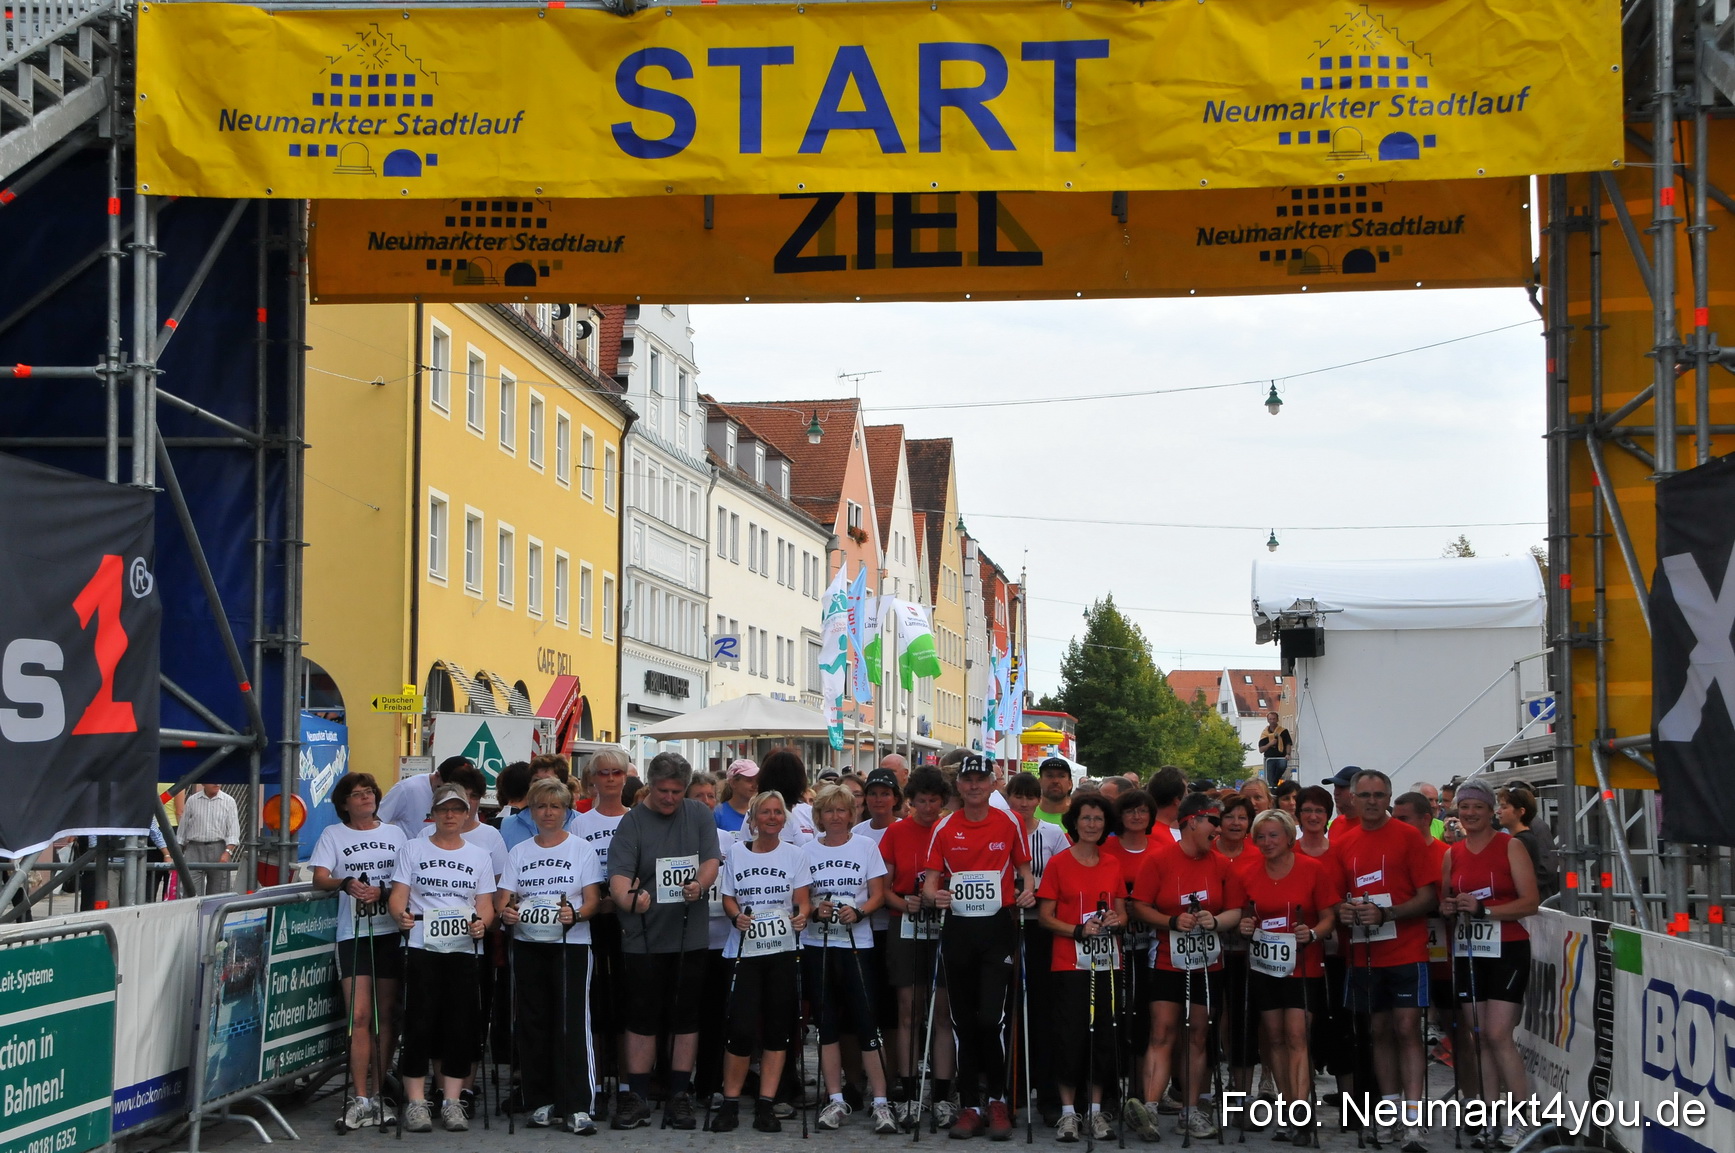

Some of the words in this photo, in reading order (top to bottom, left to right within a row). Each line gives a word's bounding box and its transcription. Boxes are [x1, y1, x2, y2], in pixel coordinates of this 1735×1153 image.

[611, 39, 1110, 159] START
[1203, 96, 1379, 124] Neumarkter
[1388, 86, 1531, 117] Stadtlauf
[218, 109, 386, 135] Neumarkter
[396, 110, 524, 136] Stadtlauf
[774, 191, 1043, 273] ZIEL
[1197, 220, 1343, 246] Neumarkter
[1349, 215, 1465, 238] Stadtlauf
[367, 232, 507, 253] Neumarkter
[512, 233, 624, 253] Stadtlauf
[537, 646, 555, 675] CAFE
[381, 696, 414, 704] Duschen
[342, 841, 396, 856] BERGER
[345, 861, 375, 871] POWER
[419, 859, 474, 876] BERGER
[521, 858, 572, 873] BERGER
[735, 867, 787, 883] BERGER
[809, 859, 861, 874] BERGER
[416, 876, 449, 888] POWER
[451, 880, 477, 890] GIRLS
[517, 878, 545, 888] POWER
[547, 875, 575, 885] GIRLS
[662, 868, 697, 887] 8022
[837, 877, 863, 886] GIRLS
[734, 887, 762, 897] POWER
[764, 884, 791, 894] GIRLS
[954, 883, 995, 901] 8055
[520, 908, 559, 925] 8087
[965, 903, 986, 911] Horst
[430, 918, 469, 937] 8089
[747, 919, 787, 940] 8013
[1457, 923, 1494, 941] 8007
[756, 939, 782, 950] Brigitte
[1176, 934, 1215, 954] 8039
[1252, 943, 1290, 962] 8019
[271, 971, 288, 996] Fun
[290, 967, 298, 992] &
[299, 963, 326, 989] Action
[268, 1002, 305, 1032] sicheren
[0, 1034, 36, 1071] ction
[40, 1027, 54, 1060] in
[285, 1047, 304, 1066] Service
[3, 1068, 65, 1118] Bahnen!
[56, 1126, 77, 1152] 6352
